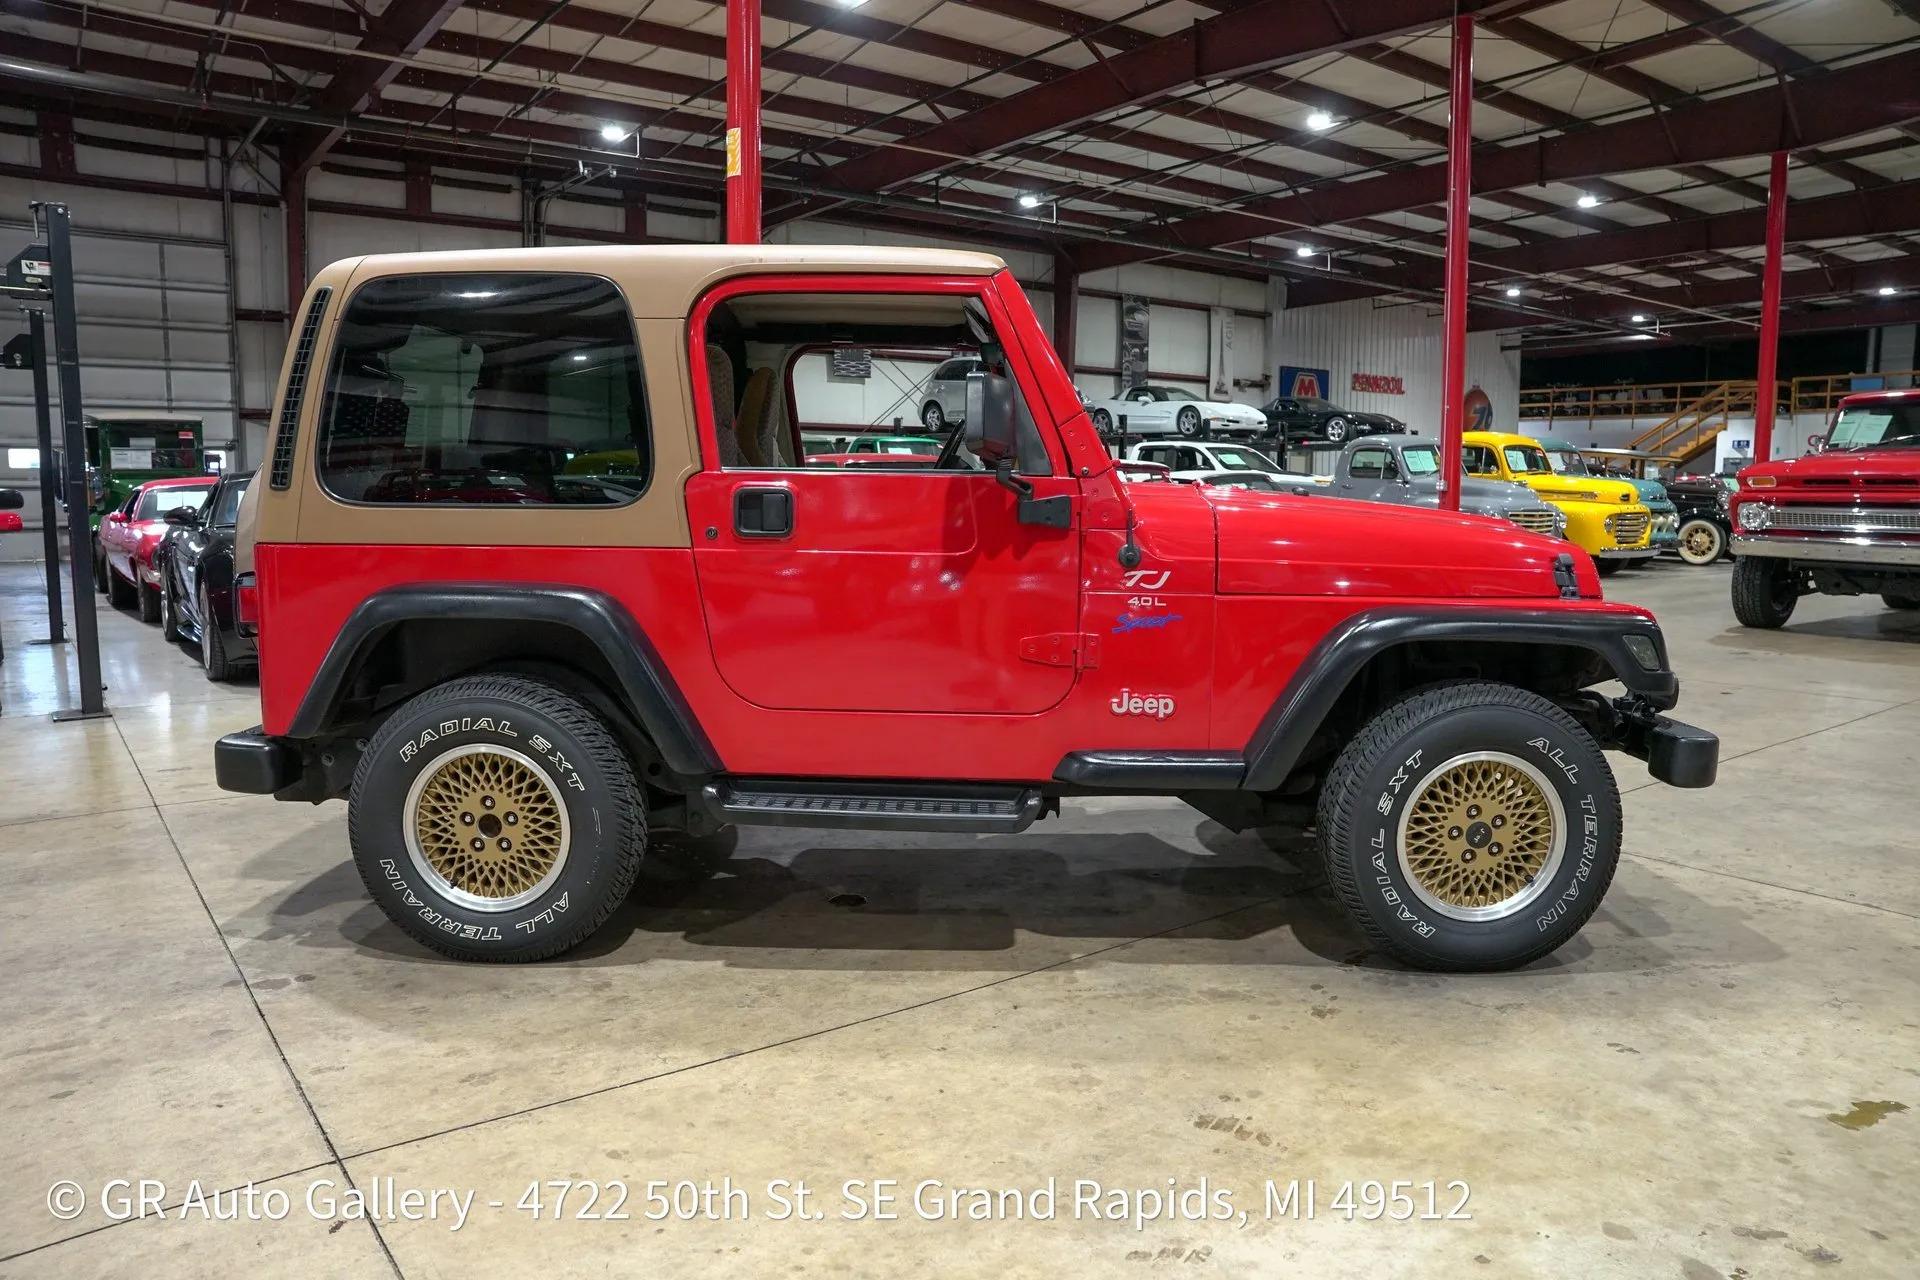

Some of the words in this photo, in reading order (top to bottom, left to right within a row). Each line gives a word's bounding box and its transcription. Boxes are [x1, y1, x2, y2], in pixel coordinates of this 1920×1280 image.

[1124, 570, 1171, 590] TJ
[1111, 689, 1174, 719] Jeep
[400, 717, 518, 763] RADIAL
[528, 734, 585, 792] SXT
[1377, 749, 1423, 816] SXT
[1526, 736, 1579, 785] ALL
[1371, 828, 1436, 939] RADIAL
[1536, 794, 1598, 932] TERRAIN
[379, 858, 502, 941] TERRAIN
[515, 891, 569, 934] ALL
